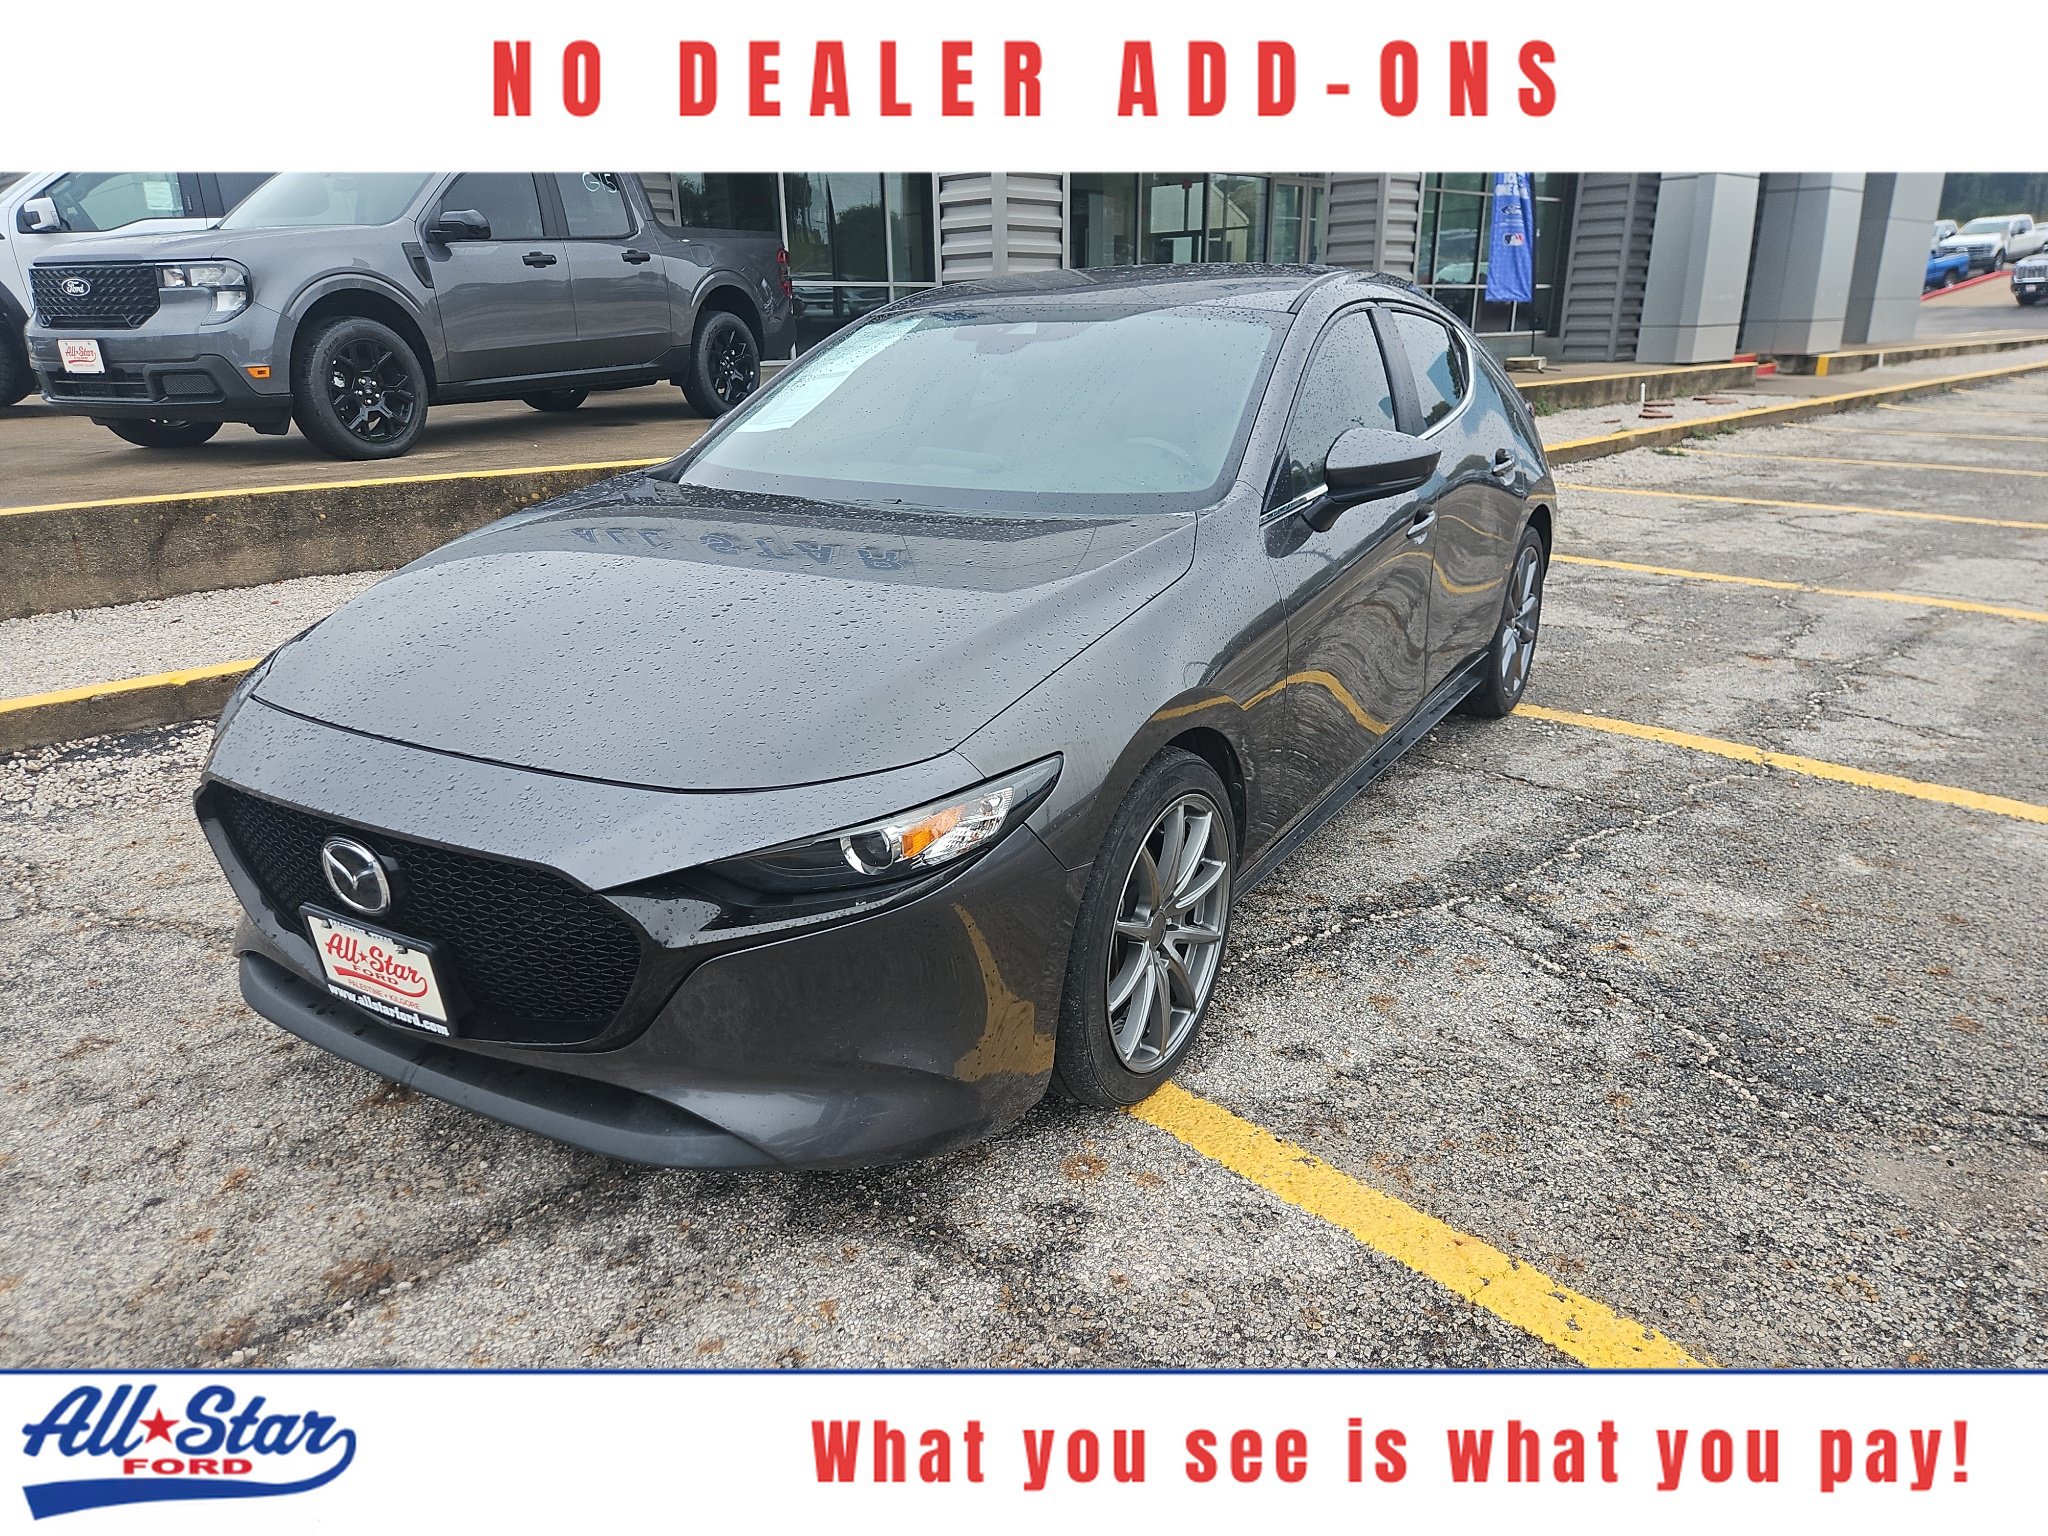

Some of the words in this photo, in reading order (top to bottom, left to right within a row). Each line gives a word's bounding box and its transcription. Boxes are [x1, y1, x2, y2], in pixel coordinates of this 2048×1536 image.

[66, 281, 85, 293] Ford
[325, 933, 360, 964] All
[369, 946, 421, 984] Star
[353, 965, 399, 985] FORD
[328, 984, 450, 1037] www.allstarford.com
